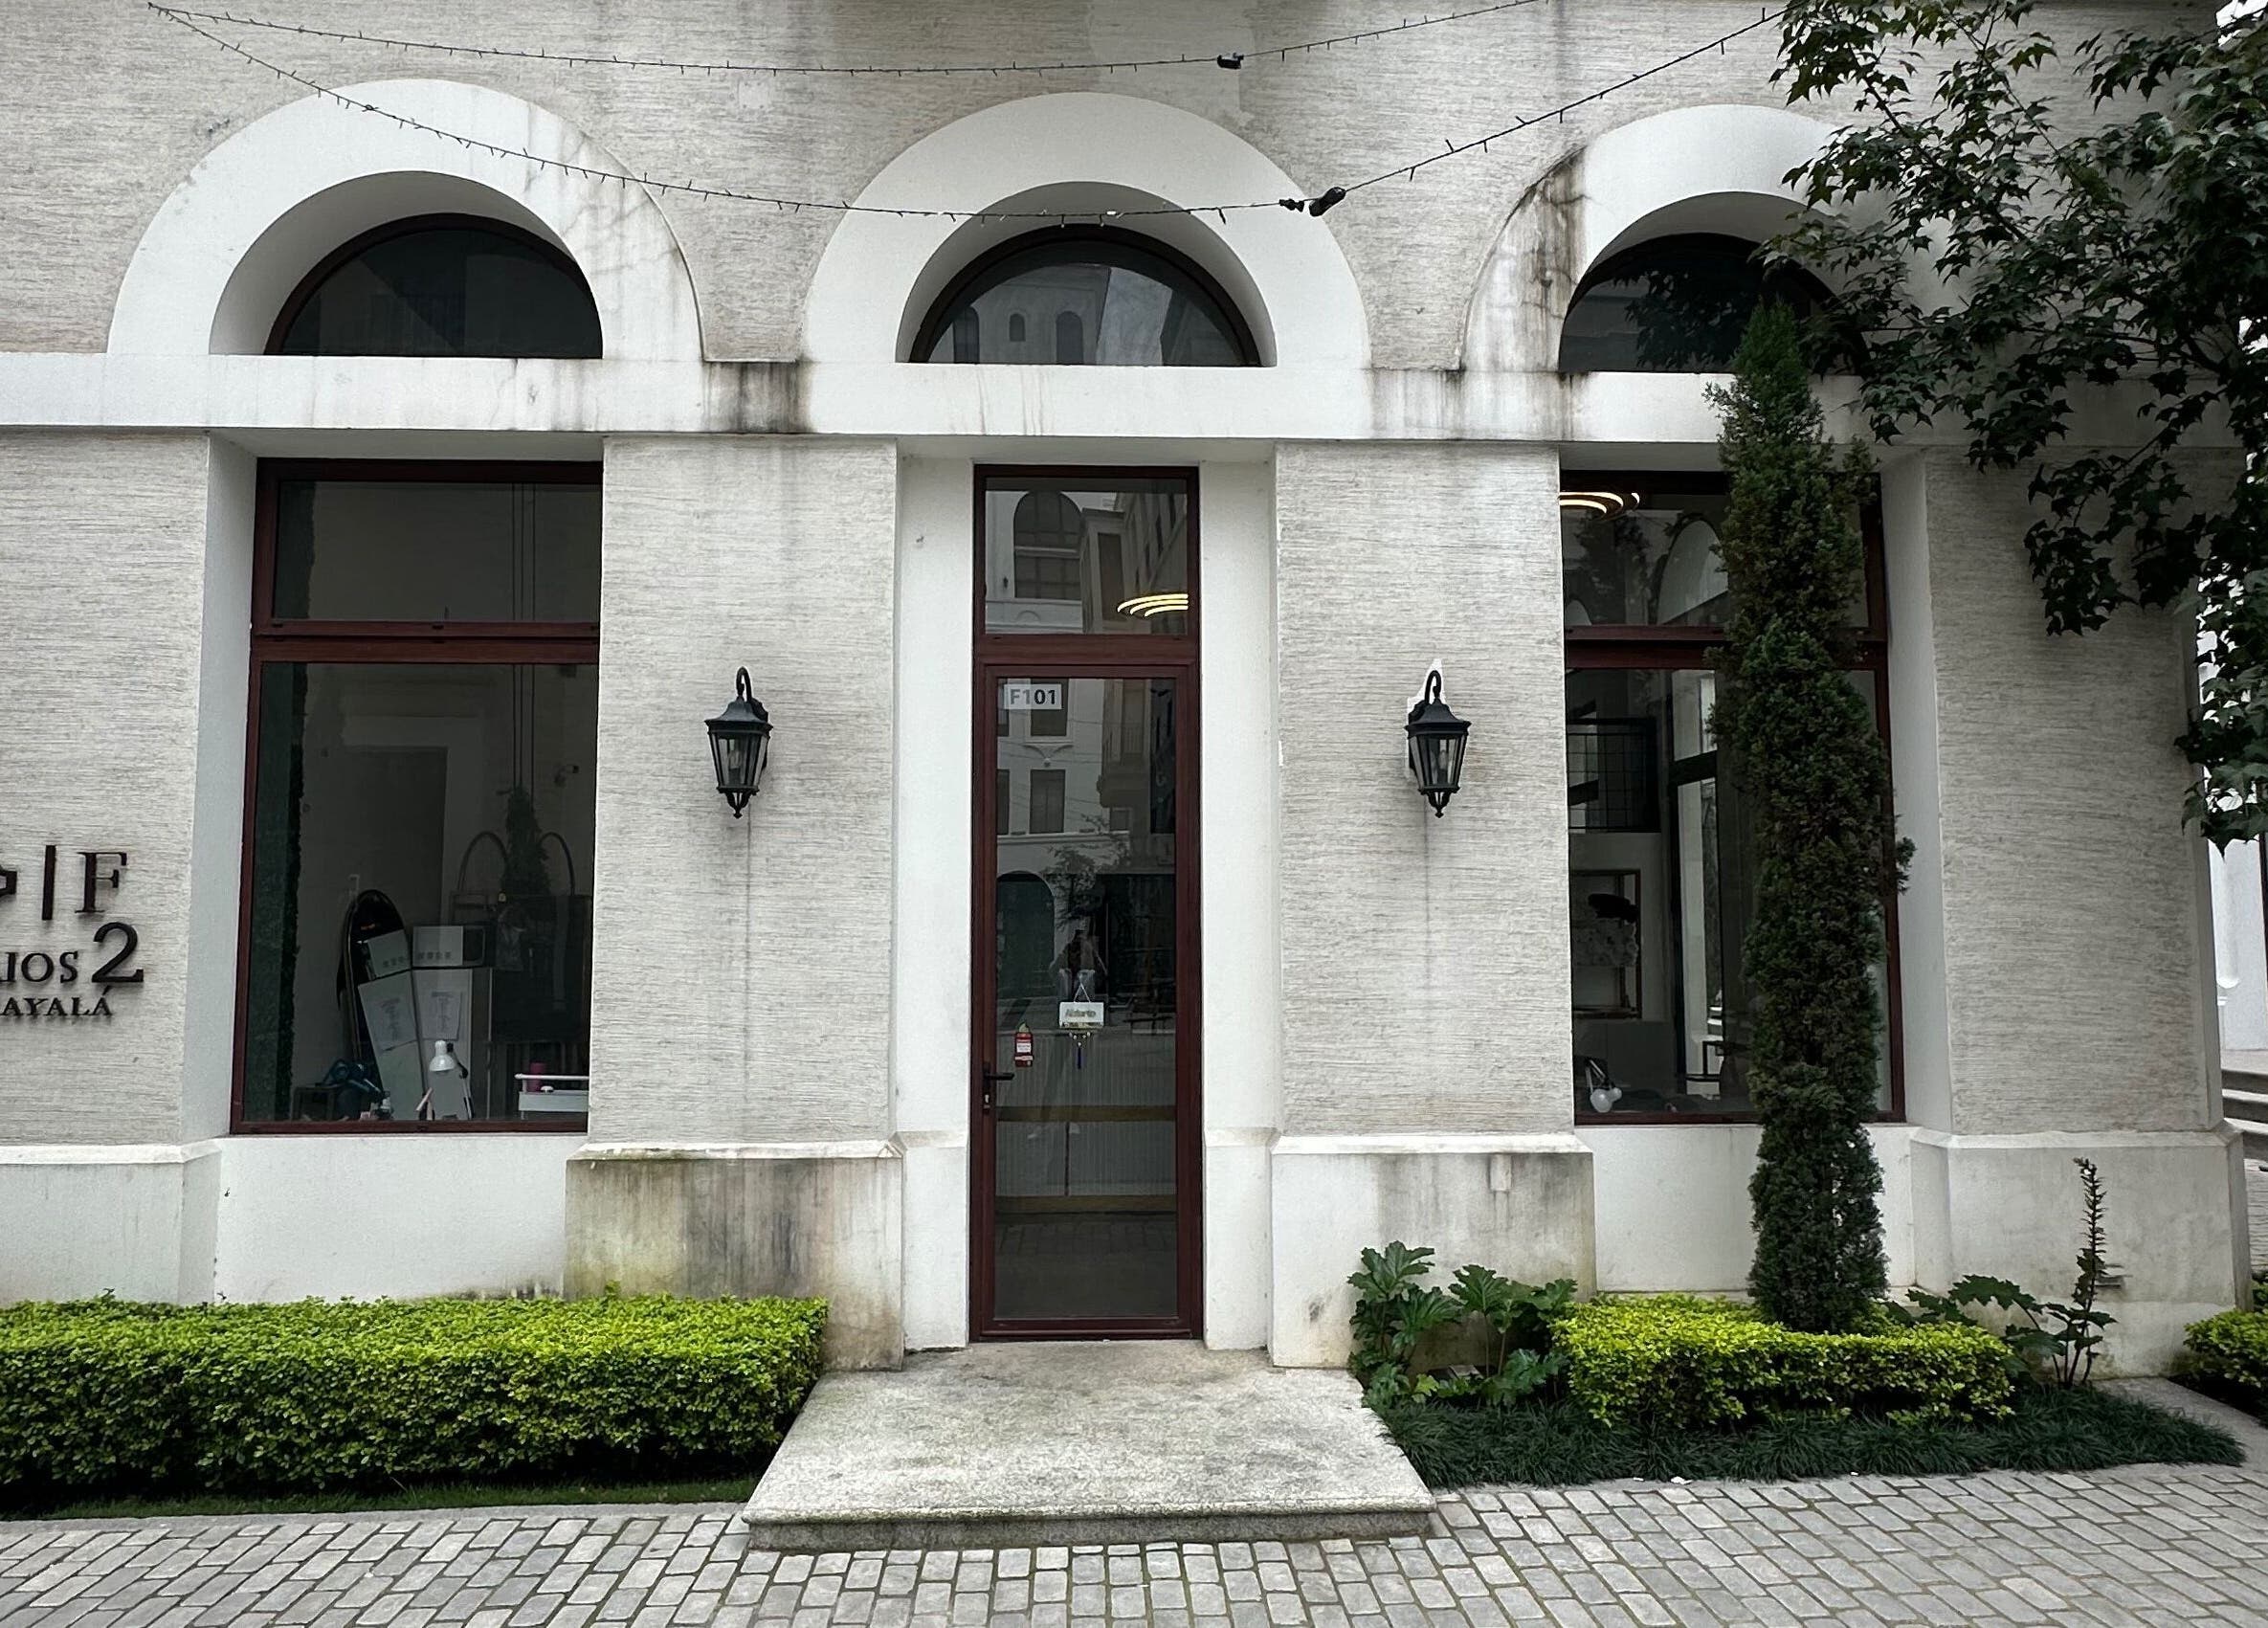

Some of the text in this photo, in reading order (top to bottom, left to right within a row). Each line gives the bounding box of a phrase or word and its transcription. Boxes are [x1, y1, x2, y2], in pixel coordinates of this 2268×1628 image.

[1010, 688, 1056, 705] F101
[74, 851, 128, 914] F
[0, 922, 144, 984] IOS 2
